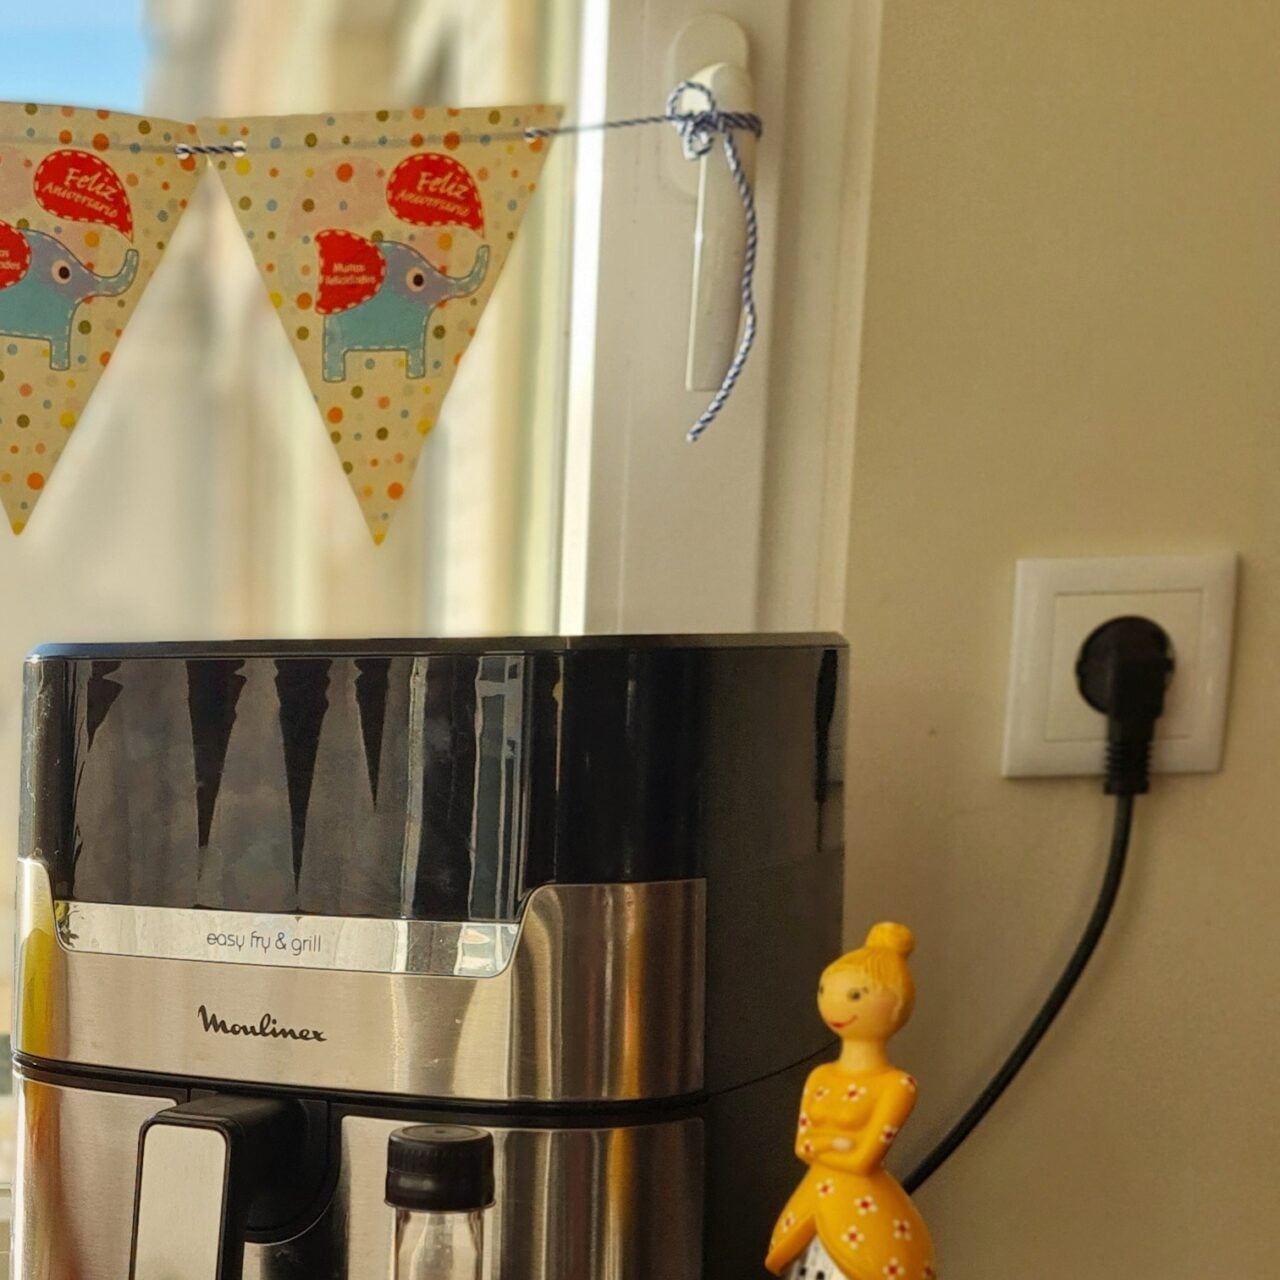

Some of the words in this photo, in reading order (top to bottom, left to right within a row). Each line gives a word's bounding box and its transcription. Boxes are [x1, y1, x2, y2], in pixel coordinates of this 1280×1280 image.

[63, 168, 118, 202] Feliz
[415, 171, 470, 201] Feliz
[206, 932, 245, 952] easy
[250, 930, 270, 954] fry
[274, 931, 287, 950] &
[291, 934, 321, 956] grill
[197, 1004, 327, 1042] Moulinex
